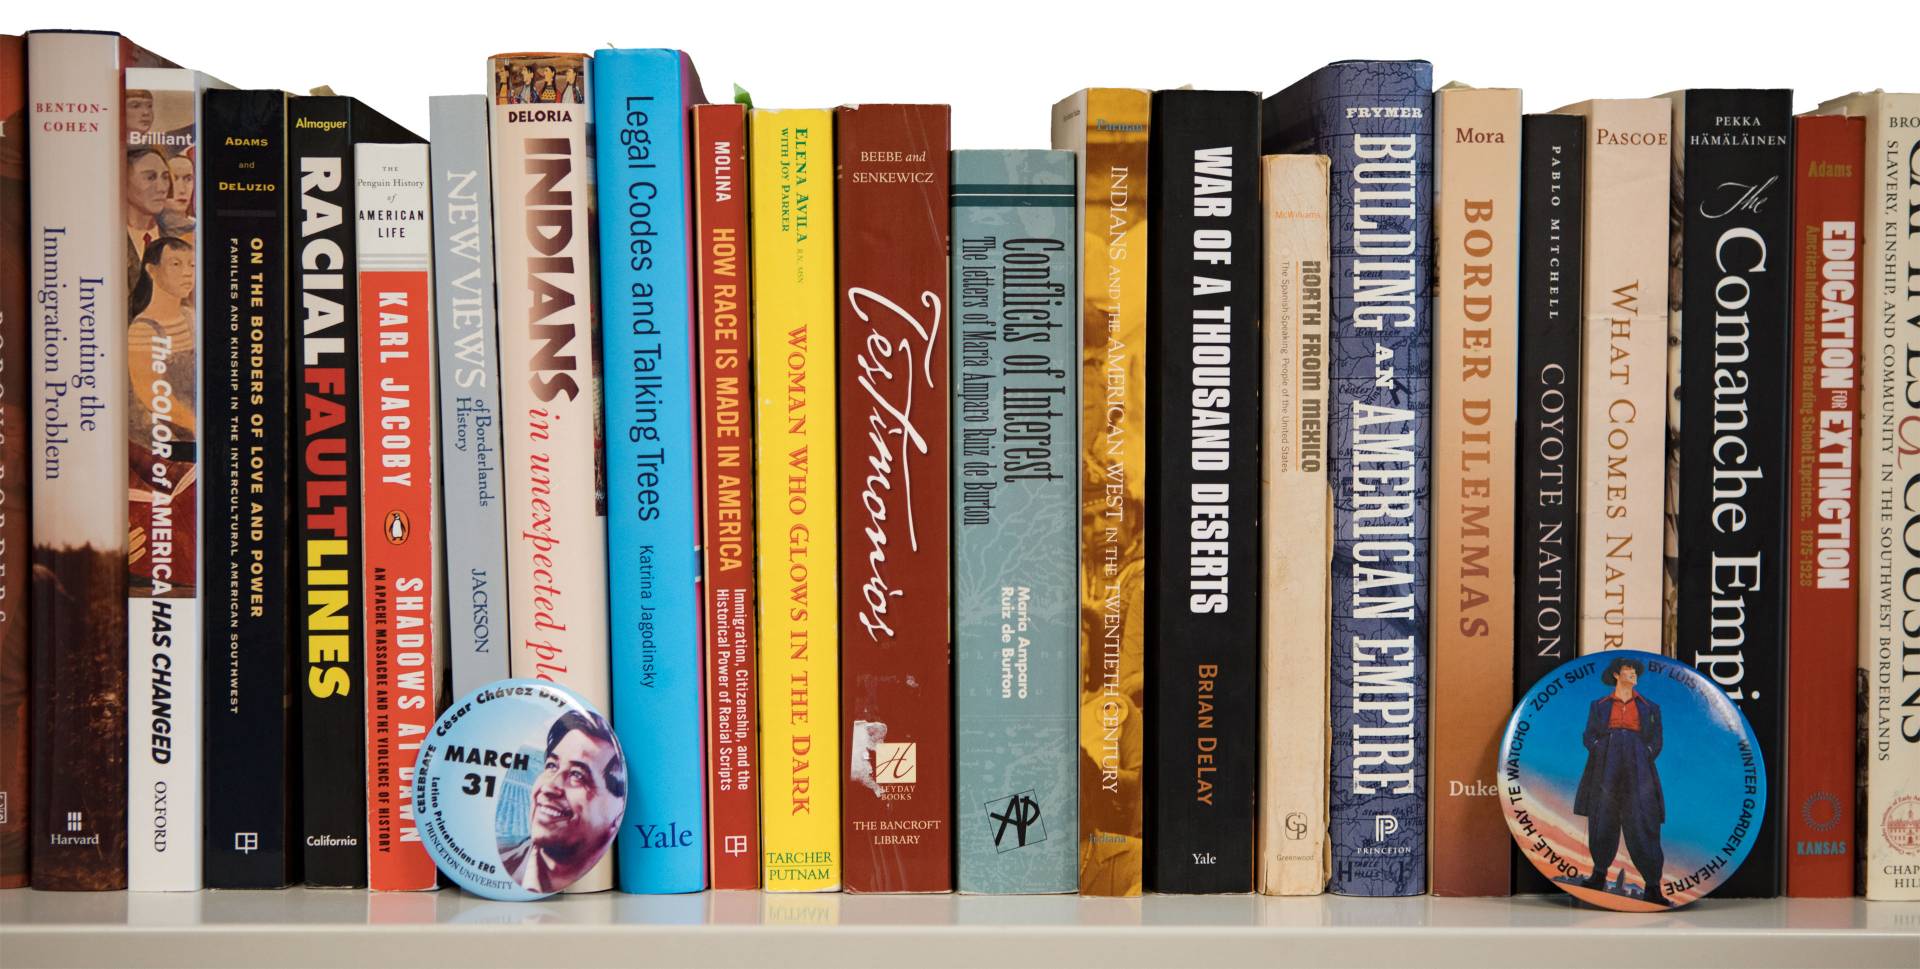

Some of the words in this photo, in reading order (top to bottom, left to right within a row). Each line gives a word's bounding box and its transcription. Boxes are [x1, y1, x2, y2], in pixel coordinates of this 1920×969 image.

[36, 103, 107, 113] BENTON-
[44, 122, 97, 132] COHEN
[296, 117, 347, 131] Almaguer
[509, 111, 572, 123] DELORIA
[620, 97, 656, 168] Legal
[1346, 107, 1423, 120] FRYMER
[1716, 116, 1760, 126] PEKKA
[130, 129, 193, 146] Brilliant
[861, 152, 902, 161] BEEBE
[906, 151, 925, 161] and
[1456, 128, 1504, 143] Mora
[1691, 133, 1786, 145] HÄMÄLÄINEN
[357, 178, 390, 189] Penguin
[394, 179, 424, 188] History
[715, 142, 731, 202] MOLINA
[853, 173, 933, 183] SENKEWICZ
[1194, 147, 1232, 216] WAR
[1551, 146, 1561, 206] PABLO
[1808, 161, 1852, 177] Adams
[1885, 141, 1898, 214] SLAVERY,
[359, 210, 423, 220] AMERICAN
[387, 193, 397, 203] of
[447, 171, 480, 263] NEW
[1700, 176, 1778, 218] The
[251, 238, 263, 263] ON
[379, 228, 405, 237] LIFE
[629, 182, 657, 271] Codes
[1194, 230, 1231, 264] OF
[1353, 134, 1416, 330] BUILDING
[523, 137, 580, 403] INDIANS
[713, 229, 735, 276] HOW
[1550, 219, 1560, 319] MITCHELL
[1884, 222, 1896, 295] KINSHIP,
[38, 227, 67, 372] Immigration
[251, 273, 263, 307] THE
[632, 283, 660, 334] and
[1003, 238, 1065, 342] Conflicts
[1193, 276, 1231, 296] A
[1463, 199, 1493, 381] BORDER
[1821, 222, 1855, 388] EDUCATION
[72, 277, 104, 388] Inventing
[379, 292, 408, 363] KARL
[452, 268, 486, 387] VIEWS
[714, 285, 737, 340] RACE
[1610, 280, 1638, 385] WHAT
[1884, 301, 1895, 338] AND
[152, 336, 173, 373] The
[251, 316, 263, 405] BORDERS
[716, 349, 737, 369] IS
[1003, 355, 1065, 378] of
[1376, 343, 1395, 390] AN
[629, 344, 662, 442] Talking
[788, 325, 807, 435] WOMAN
[1192, 306, 1231, 470] THOUSAND
[1712, 227, 1766, 533] Comanche
[1832, 390, 1847, 408] FOR
[1882, 344, 1895, 452] COMMUNITY
[45, 382, 68, 480] Problem
[80, 396, 105, 431] the
[152, 380, 173, 461] COLOR
[251, 414, 263, 437] OF
[716, 377, 739, 437] MADE
[381, 378, 411, 486] JACOBY
[718, 446, 739, 466] IN
[1003, 386, 1065, 482] Interest
[1540, 364, 1565, 506] COYOTE
[152, 463, 172, 488] of
[251, 447, 263, 493] LOVE
[789, 445, 808, 515] WHO
[848, 287, 941, 641] Testimonios
[1606, 399, 1636, 518] COMES
[1882, 464, 1893, 481] IN
[637, 448, 664, 521] Trees
[1817, 411, 1852, 588] EXTINCTION
[1881, 488, 1892, 520] THE
[251, 502, 263, 541] AND
[718, 475, 742, 571] AMERICA
[1350, 399, 1417, 621] AMERICAN
[1459, 399, 1492, 638] DILEMMAS
[150, 490, 173, 595] AMERICA
[1190, 484, 1229, 613] DESERTS
[251, 550, 263, 616] POWER
[375, 568, 385, 578] AN
[640, 546, 654, 598] Katrina
[789, 524, 809, 621] GLOWS
[1538, 522, 1562, 658] NATION
[1880, 528, 1892, 631] SOUTHWEST
[152, 601, 171, 648] HAS
[375, 586, 386, 624] APACHE
[472, 569, 488, 653] JACKSON
[1002, 587, 1015, 618] Ruiz
[1018, 587, 1031, 631] María
[376, 629, 387, 685] MASSACRE
[396, 578, 425, 709] SHADOWS
[638, 605, 656, 688] Jagodinsky
[791, 630, 808, 661] IN
[1002, 624, 1015, 643] de
[1002, 648, 1014, 698] Burton
[1014, 637, 1030, 699] Amparo
[1567, 662, 1595, 683] SUIT
[152, 654, 171, 764] CHANGED
[377, 691, 388, 710] AND
[791, 671, 808, 725] THE
[1198, 665, 1218, 728] BRIAN
[1351, 636, 1416, 796] EMPIRE
[1530, 677, 1568, 711] ZOOT
[1879, 638, 1891, 760] BORDERLANDS
[377, 715, 388, 733] THE
[378, 738, 389, 787] VIOLENCE
[416, 744, 437, 815] CELEBRATE
[436, 702, 471, 736] César
[476, 688, 533, 704] Chávez
[445, 745, 529, 771] MARCH
[1506, 719, 1530, 782] WATCHO
[1738, 738, 1758, 794] WINTER
[378, 792, 389, 803] OF
[432, 777, 440, 808] Latino
[462, 773, 496, 797] 31
[792, 735, 810, 816] DARK
[1450, 779, 1498, 796] Duke
[1509, 786, 1521, 805] TE
[51, 834, 99, 844] Harvard
[155, 781, 166, 852] OXFORD
[307, 835, 357, 846] California
[379, 808, 390, 852] HISTORY
[434, 811, 475, 867] Princetonians
[637, 821, 692, 852] Yale
[853, 822, 877, 830] THE
[881, 821, 941, 830] BANCROFT
[875, 835, 920, 844] LIBRARY
[1513, 810, 1537, 837] HAY
[1722, 799, 1756, 857] GARDEN
[424, 821, 459, 870] PRINCETON
[459, 864, 514, 891] UNIVERSITY
[478, 861, 495, 874] ERG
[765, 852, 832, 865] TARCHER
[770, 869, 829, 880] PUTNAM
[1192, 853, 1216, 864] Yale
[1358, 845, 1412, 855] PRINCETON
[1662, 854, 1727, 897] THEATRE
